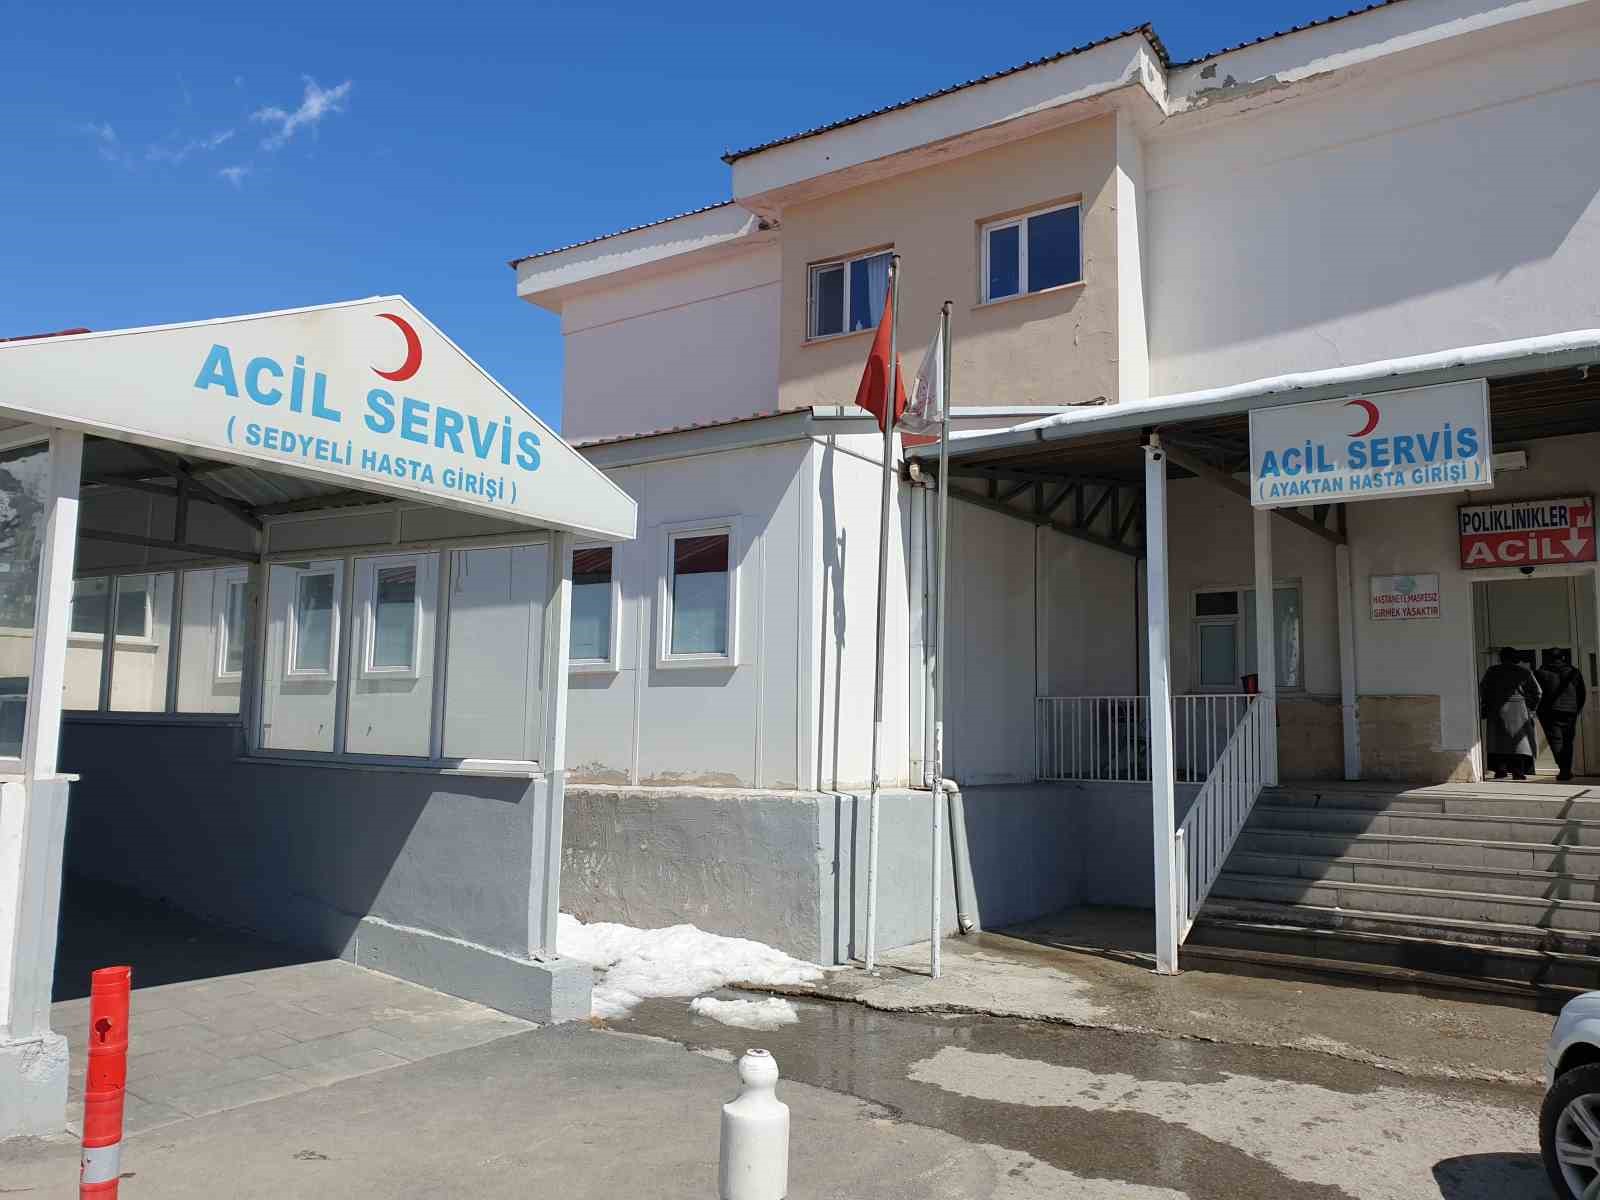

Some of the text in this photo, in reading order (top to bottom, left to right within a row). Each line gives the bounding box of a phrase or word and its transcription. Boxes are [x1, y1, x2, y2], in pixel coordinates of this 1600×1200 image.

[194, 343, 541, 472] ACİL SERVİS
[245, 423, 353, 466] SEDYELİ
[361, 449, 434, 485] HASTA
[442, 467, 504, 503] GİRİŞİ
[1260, 423, 1479, 478] ACİL SERVİS
[1270, 477, 1344, 498] AYAKTAN
[1351, 469, 1405, 490] HASTA
[1412, 463, 1467, 484] GİRİŞİ
[1464, 532, 1565, 563] ACİL
